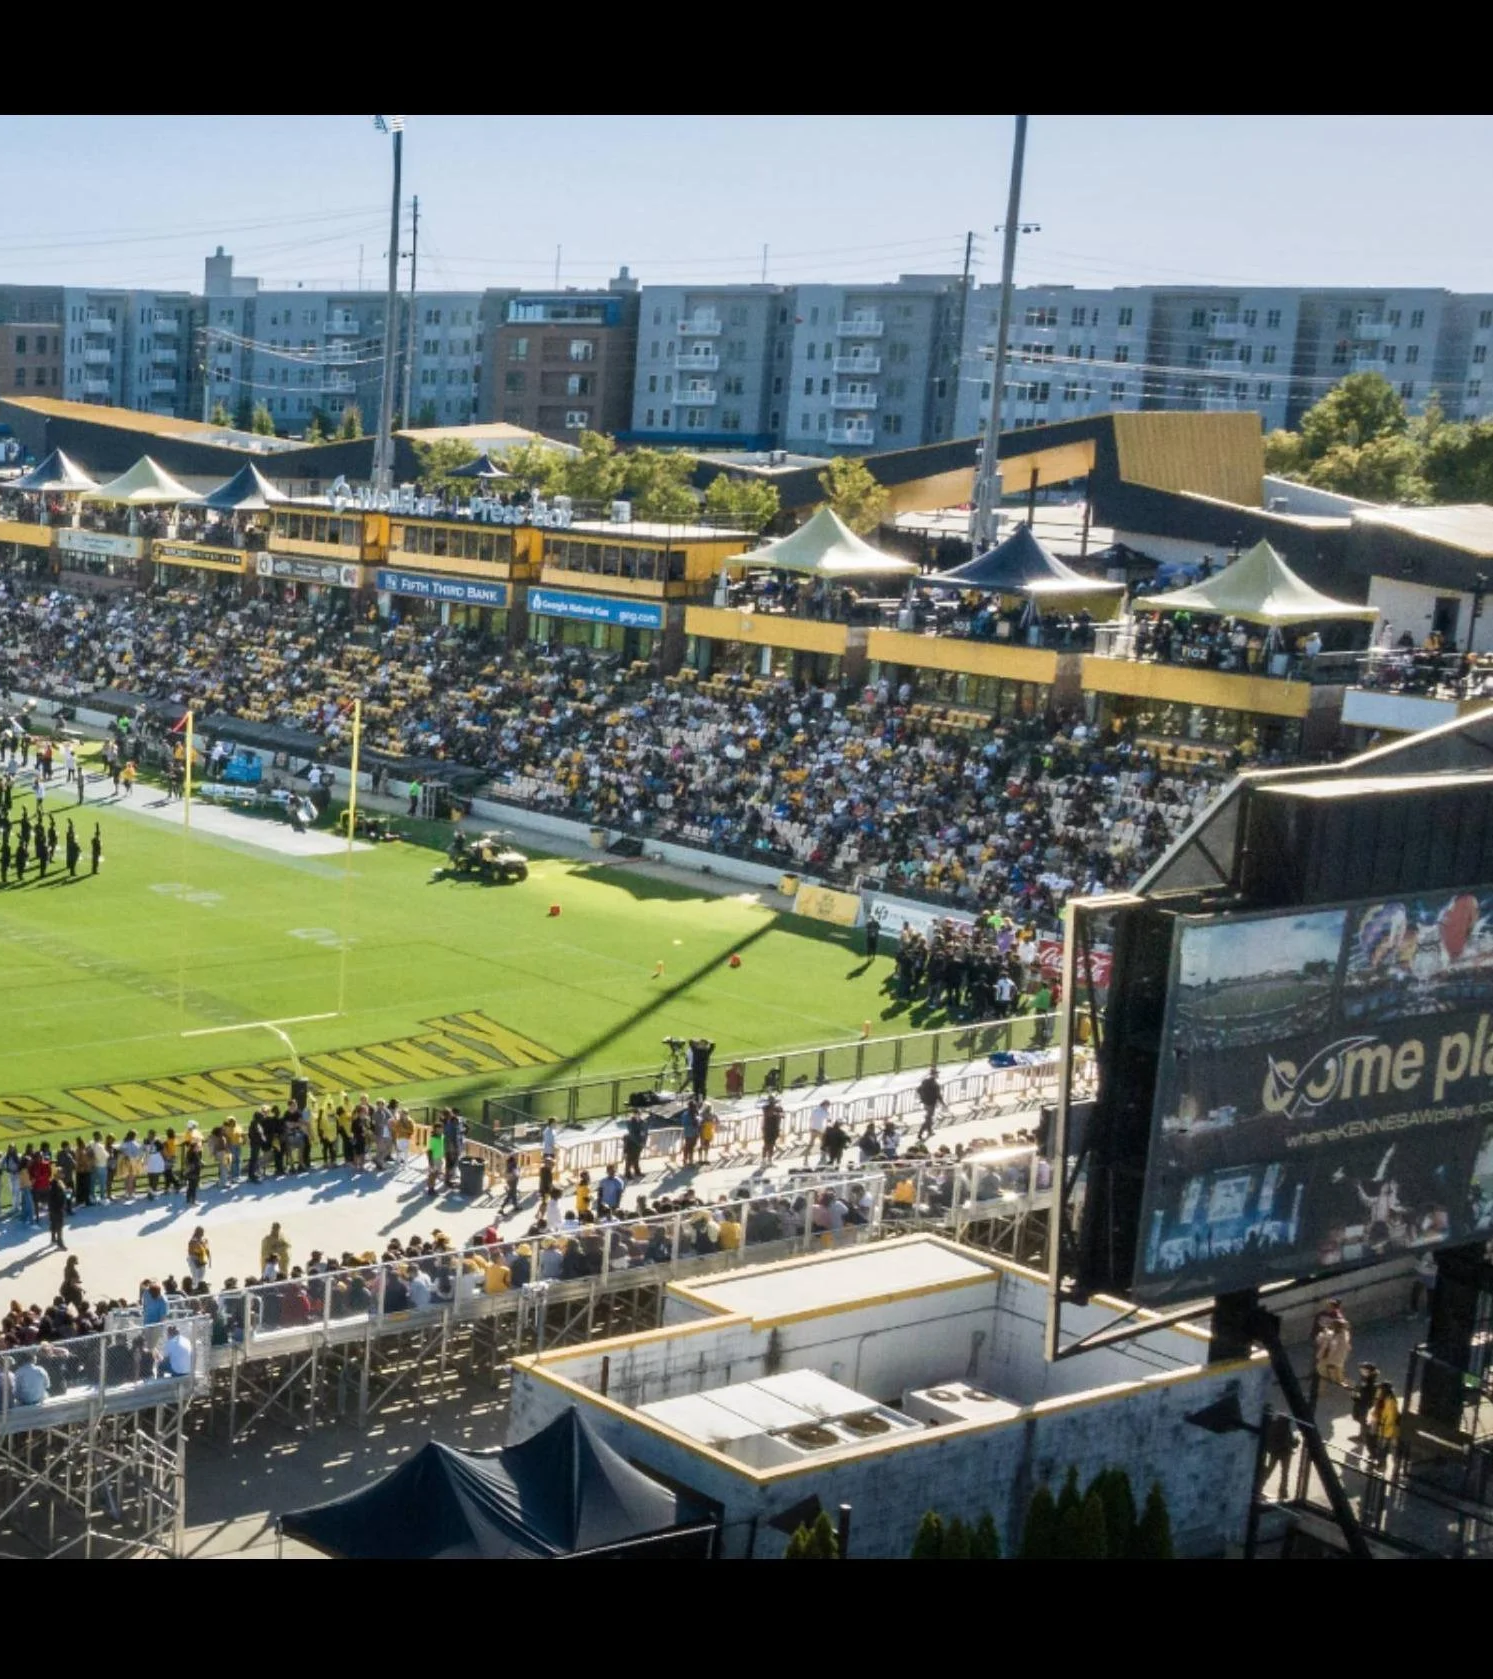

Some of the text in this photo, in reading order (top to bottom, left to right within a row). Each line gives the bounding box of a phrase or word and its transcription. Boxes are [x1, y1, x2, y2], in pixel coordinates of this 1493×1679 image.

[469, 495, 526, 525] Press
[401, 578, 498, 602] FIFTH THIRD BANK
